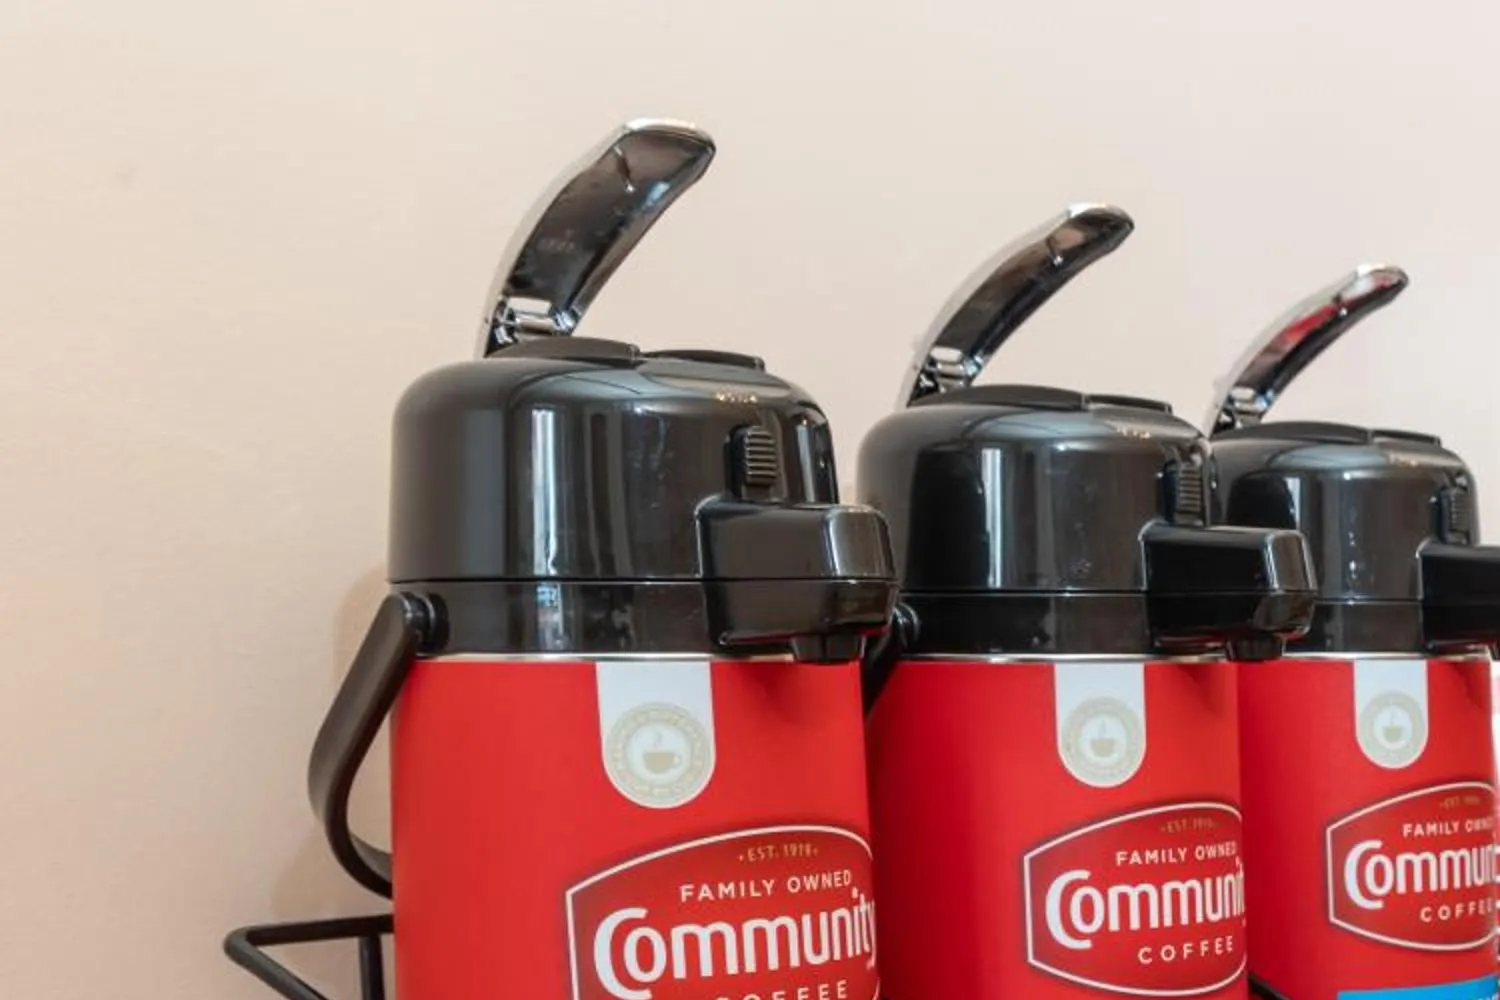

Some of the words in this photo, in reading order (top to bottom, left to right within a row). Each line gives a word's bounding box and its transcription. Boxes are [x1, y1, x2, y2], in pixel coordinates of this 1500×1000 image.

[1403, 820, 1459, 837] FAMILY
[1116, 847, 1187, 867] FAMILY
[681, 880, 775, 903] FAMILY
[787, 868, 852, 894] OWNED
[1344, 839, 1496, 910] Commun
[594, 886, 876, 1000] Community
[1138, 935, 1234, 964] COFFEE
